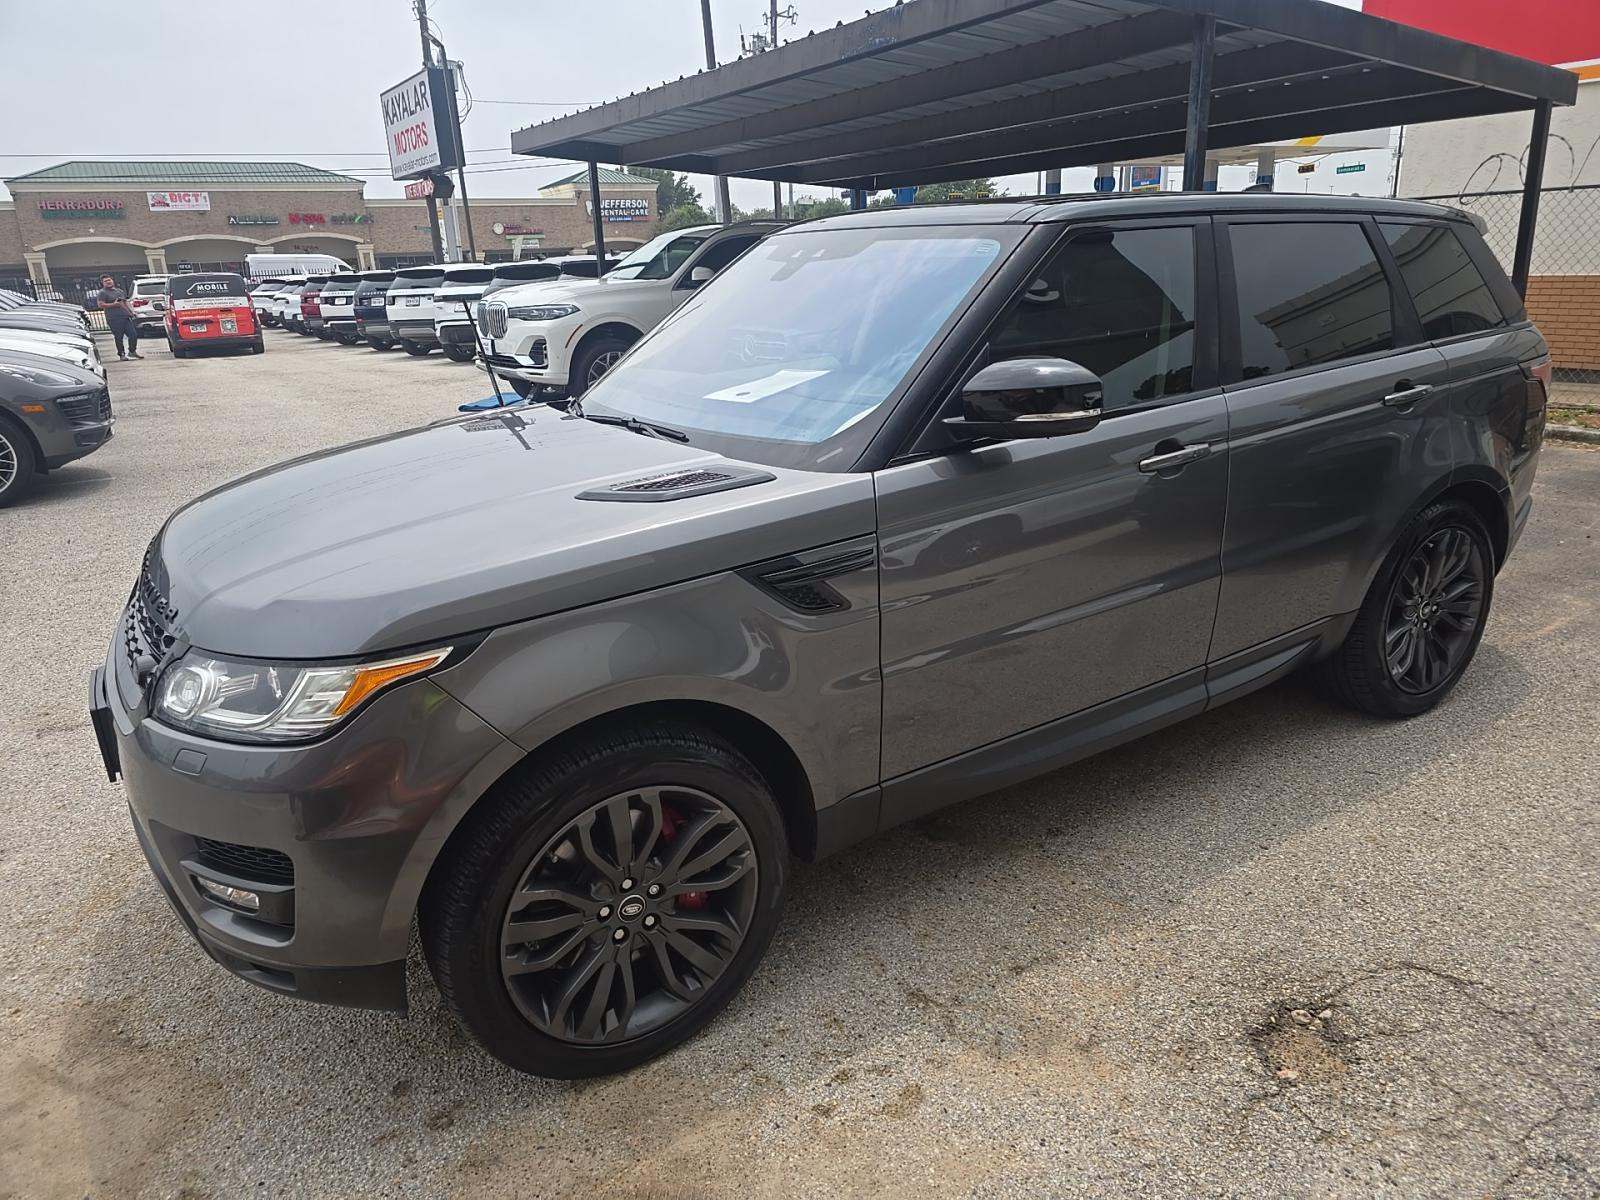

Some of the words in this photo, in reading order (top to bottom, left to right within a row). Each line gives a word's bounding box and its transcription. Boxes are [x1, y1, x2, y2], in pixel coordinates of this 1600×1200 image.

[384, 80, 430, 126] KAYALAR
[394, 121, 428, 156] MOTORS
[37, 200, 124, 210] HERRADURA
[600, 199, 649, 208] JEFFERSON
[630, 208, 649, 216] CARE
[196, 283, 228, 291] MOBILE
